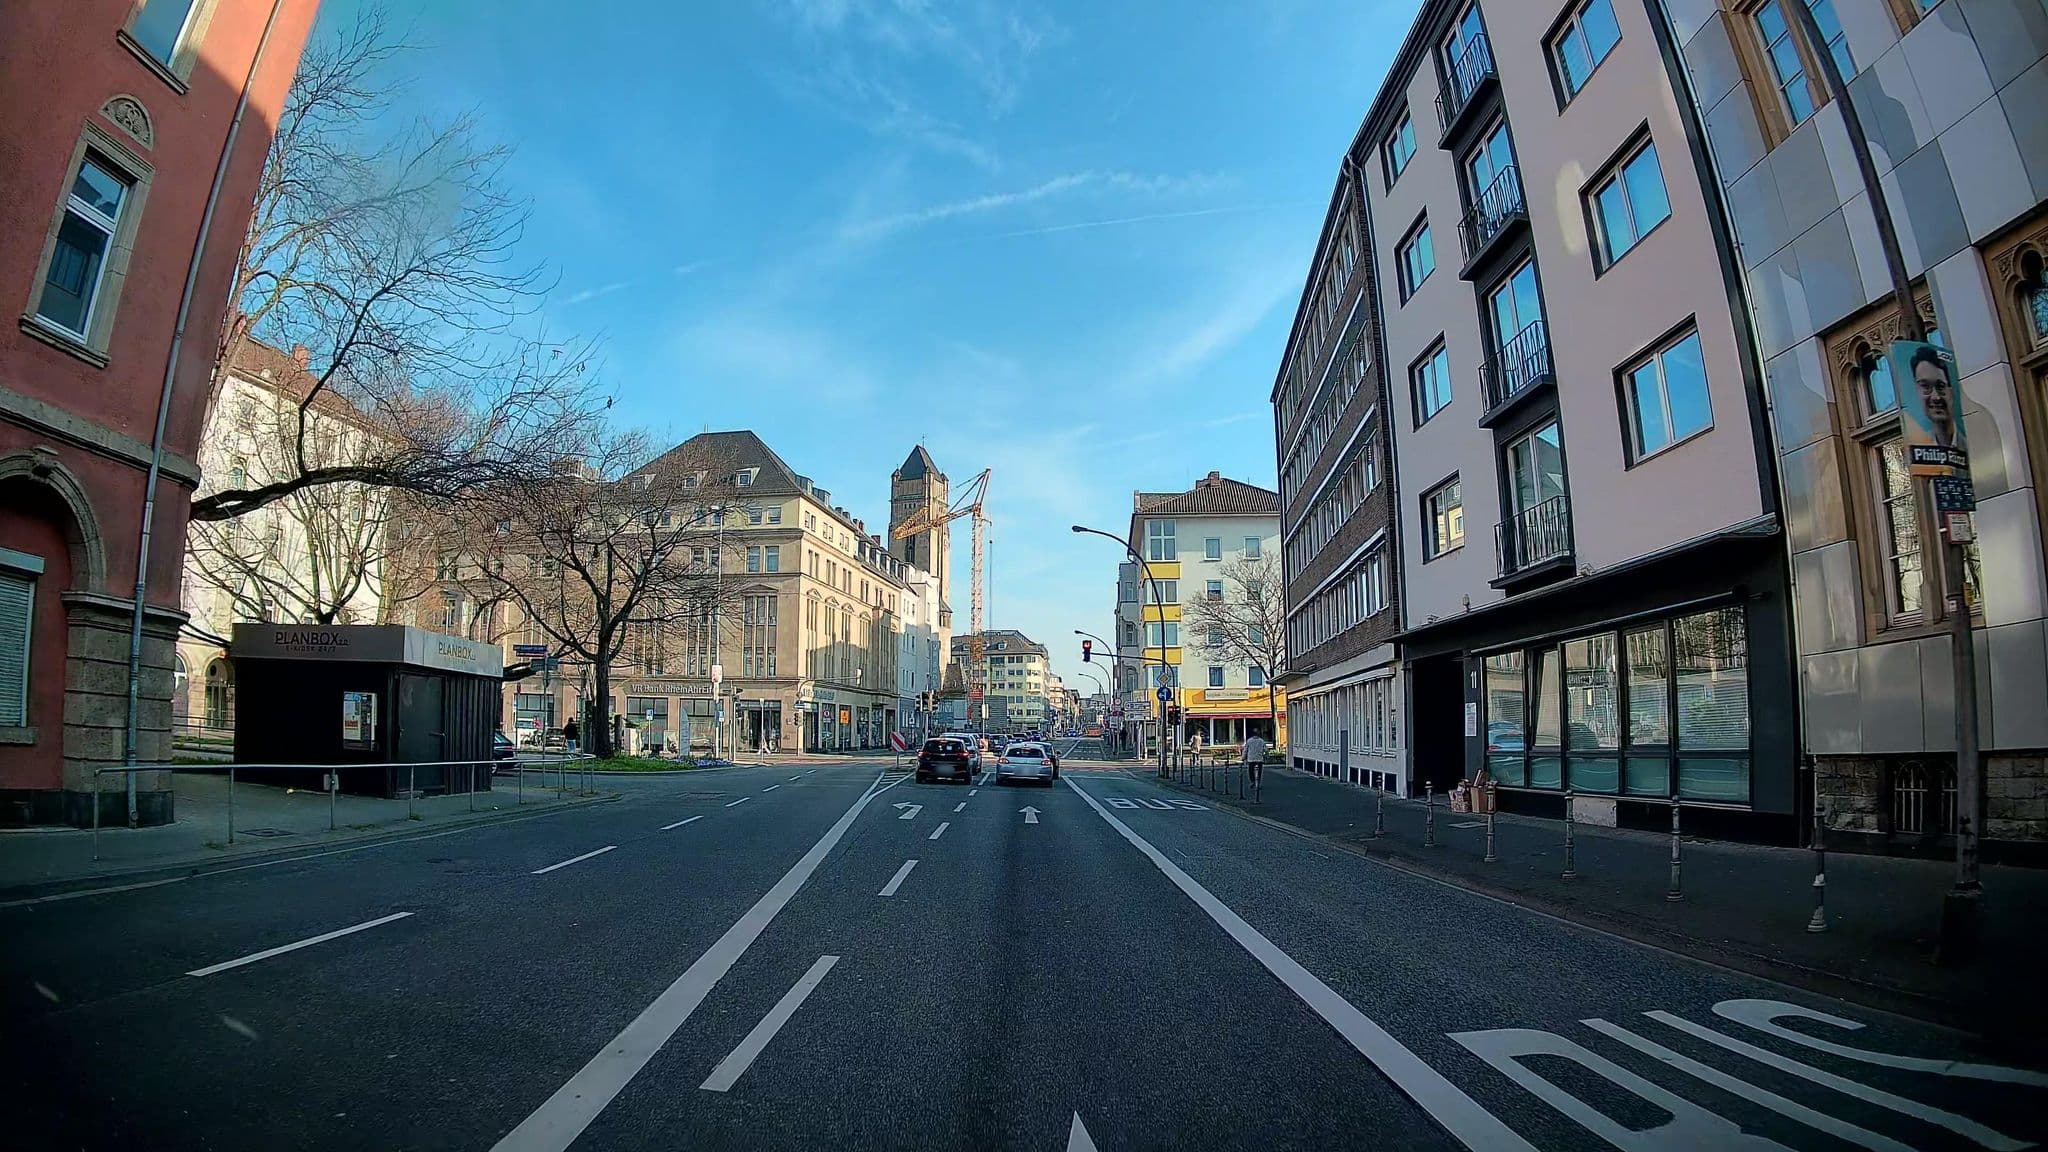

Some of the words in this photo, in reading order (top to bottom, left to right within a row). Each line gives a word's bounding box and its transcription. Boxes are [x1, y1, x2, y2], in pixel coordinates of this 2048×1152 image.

[1914, 448, 1947, 464] Philip
[275, 631, 339, 645] PLANBOX
[438, 641, 472, 660] PLANBOX
[632, 684, 643, 693] VR
[644, 684, 664, 694] Bank
[665, 684, 712, 694] RheinAhrEif
[1104, 797, 1211, 811] BUS
